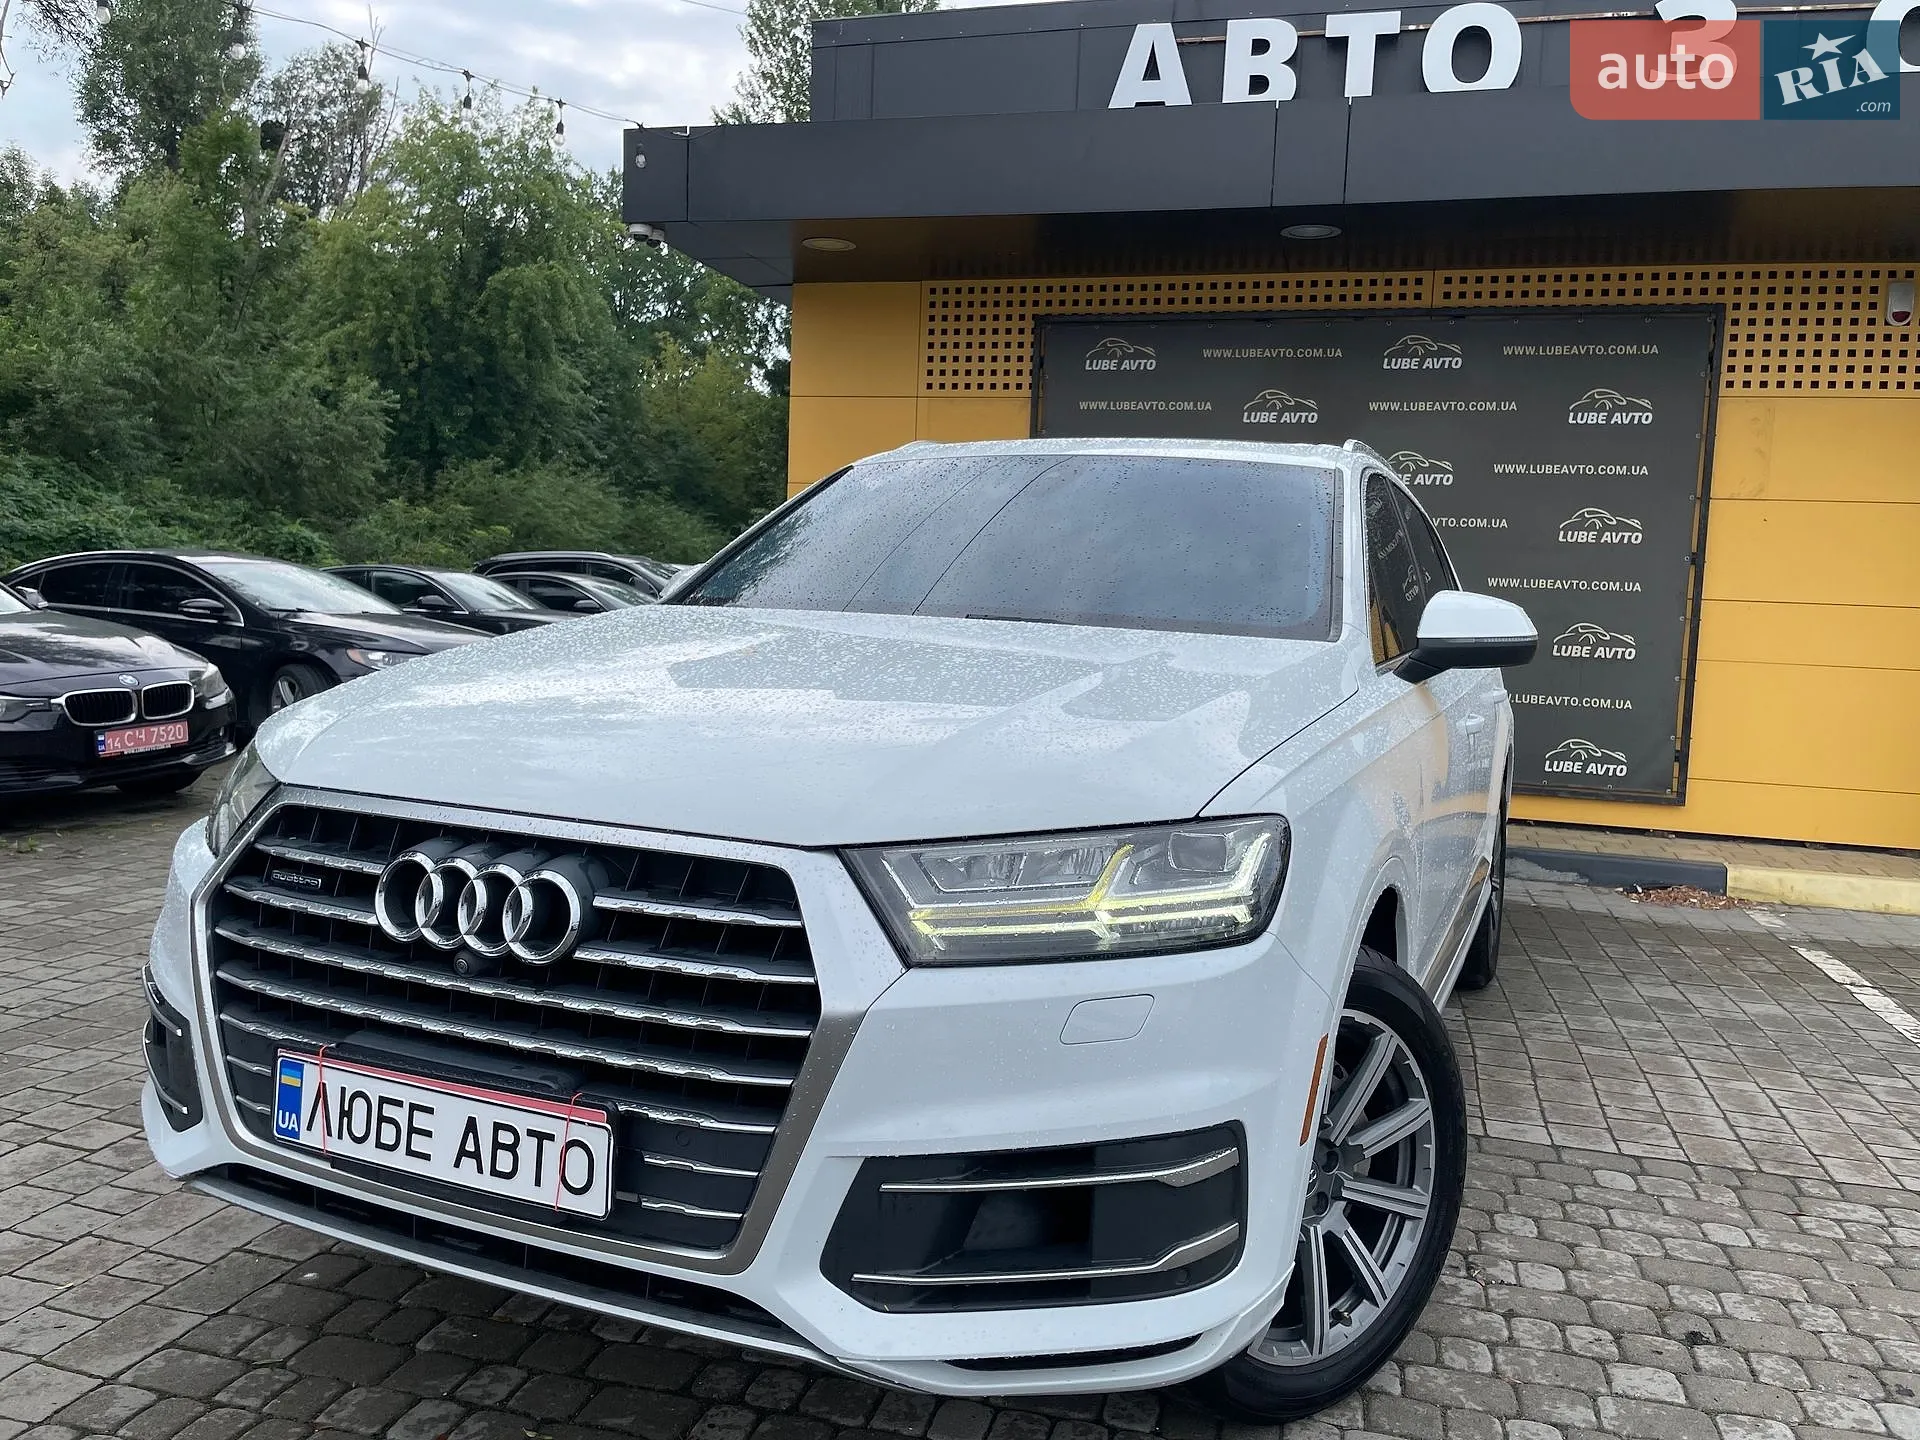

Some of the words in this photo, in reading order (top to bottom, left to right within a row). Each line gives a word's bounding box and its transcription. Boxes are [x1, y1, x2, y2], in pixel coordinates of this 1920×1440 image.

[1108, 2, 1523, 108] АВТО
[1202, 348, 1343, 358] WWW.LUBEAVTO.COM.UA
[1502, 345, 1659, 355] WWW.LUBEAVTO.COM.UA
[1085, 359, 1118, 371] LUBE
[1121, 359, 1156, 371] AVTO
[1383, 357, 1420, 370] LUBE
[1422, 357, 1462, 370] AVTO
[1079, 400, 1212, 411] WWW.LUBEAVTO.COM.UA
[1368, 400, 1518, 411] WWW.LUBEAVTO.COM.UA
[1242, 411, 1277, 424] LUBE
[1280, 411, 1318, 424] AVTO
[1568, 412, 1607, 425] LUBE
[1610, 412, 1653, 425] AVTO
[1493, 463, 1648, 476] WWW.LUBEAVTO.COM.UA
[1413, 473, 1453, 486] AVTO
[1558, 530, 1597, 544] LUBE
[1599, 531, 1643, 545] AVTO
[1487, 577, 1642, 593] WWW.LUBEAVTO.COM.UA
[1552, 645, 1592, 659] LUBE
[1594, 646, 1636, 660] AVTO
[150, 725, 183, 743] 7520
[1544, 760, 1584, 774] LUBE
[1585, 761, 1628, 777] AVTO
[278, 1109, 299, 1133] UA
[306, 1081, 435, 1162] ЛЮБЕ
[453, 1115, 596, 1196] АВТО
